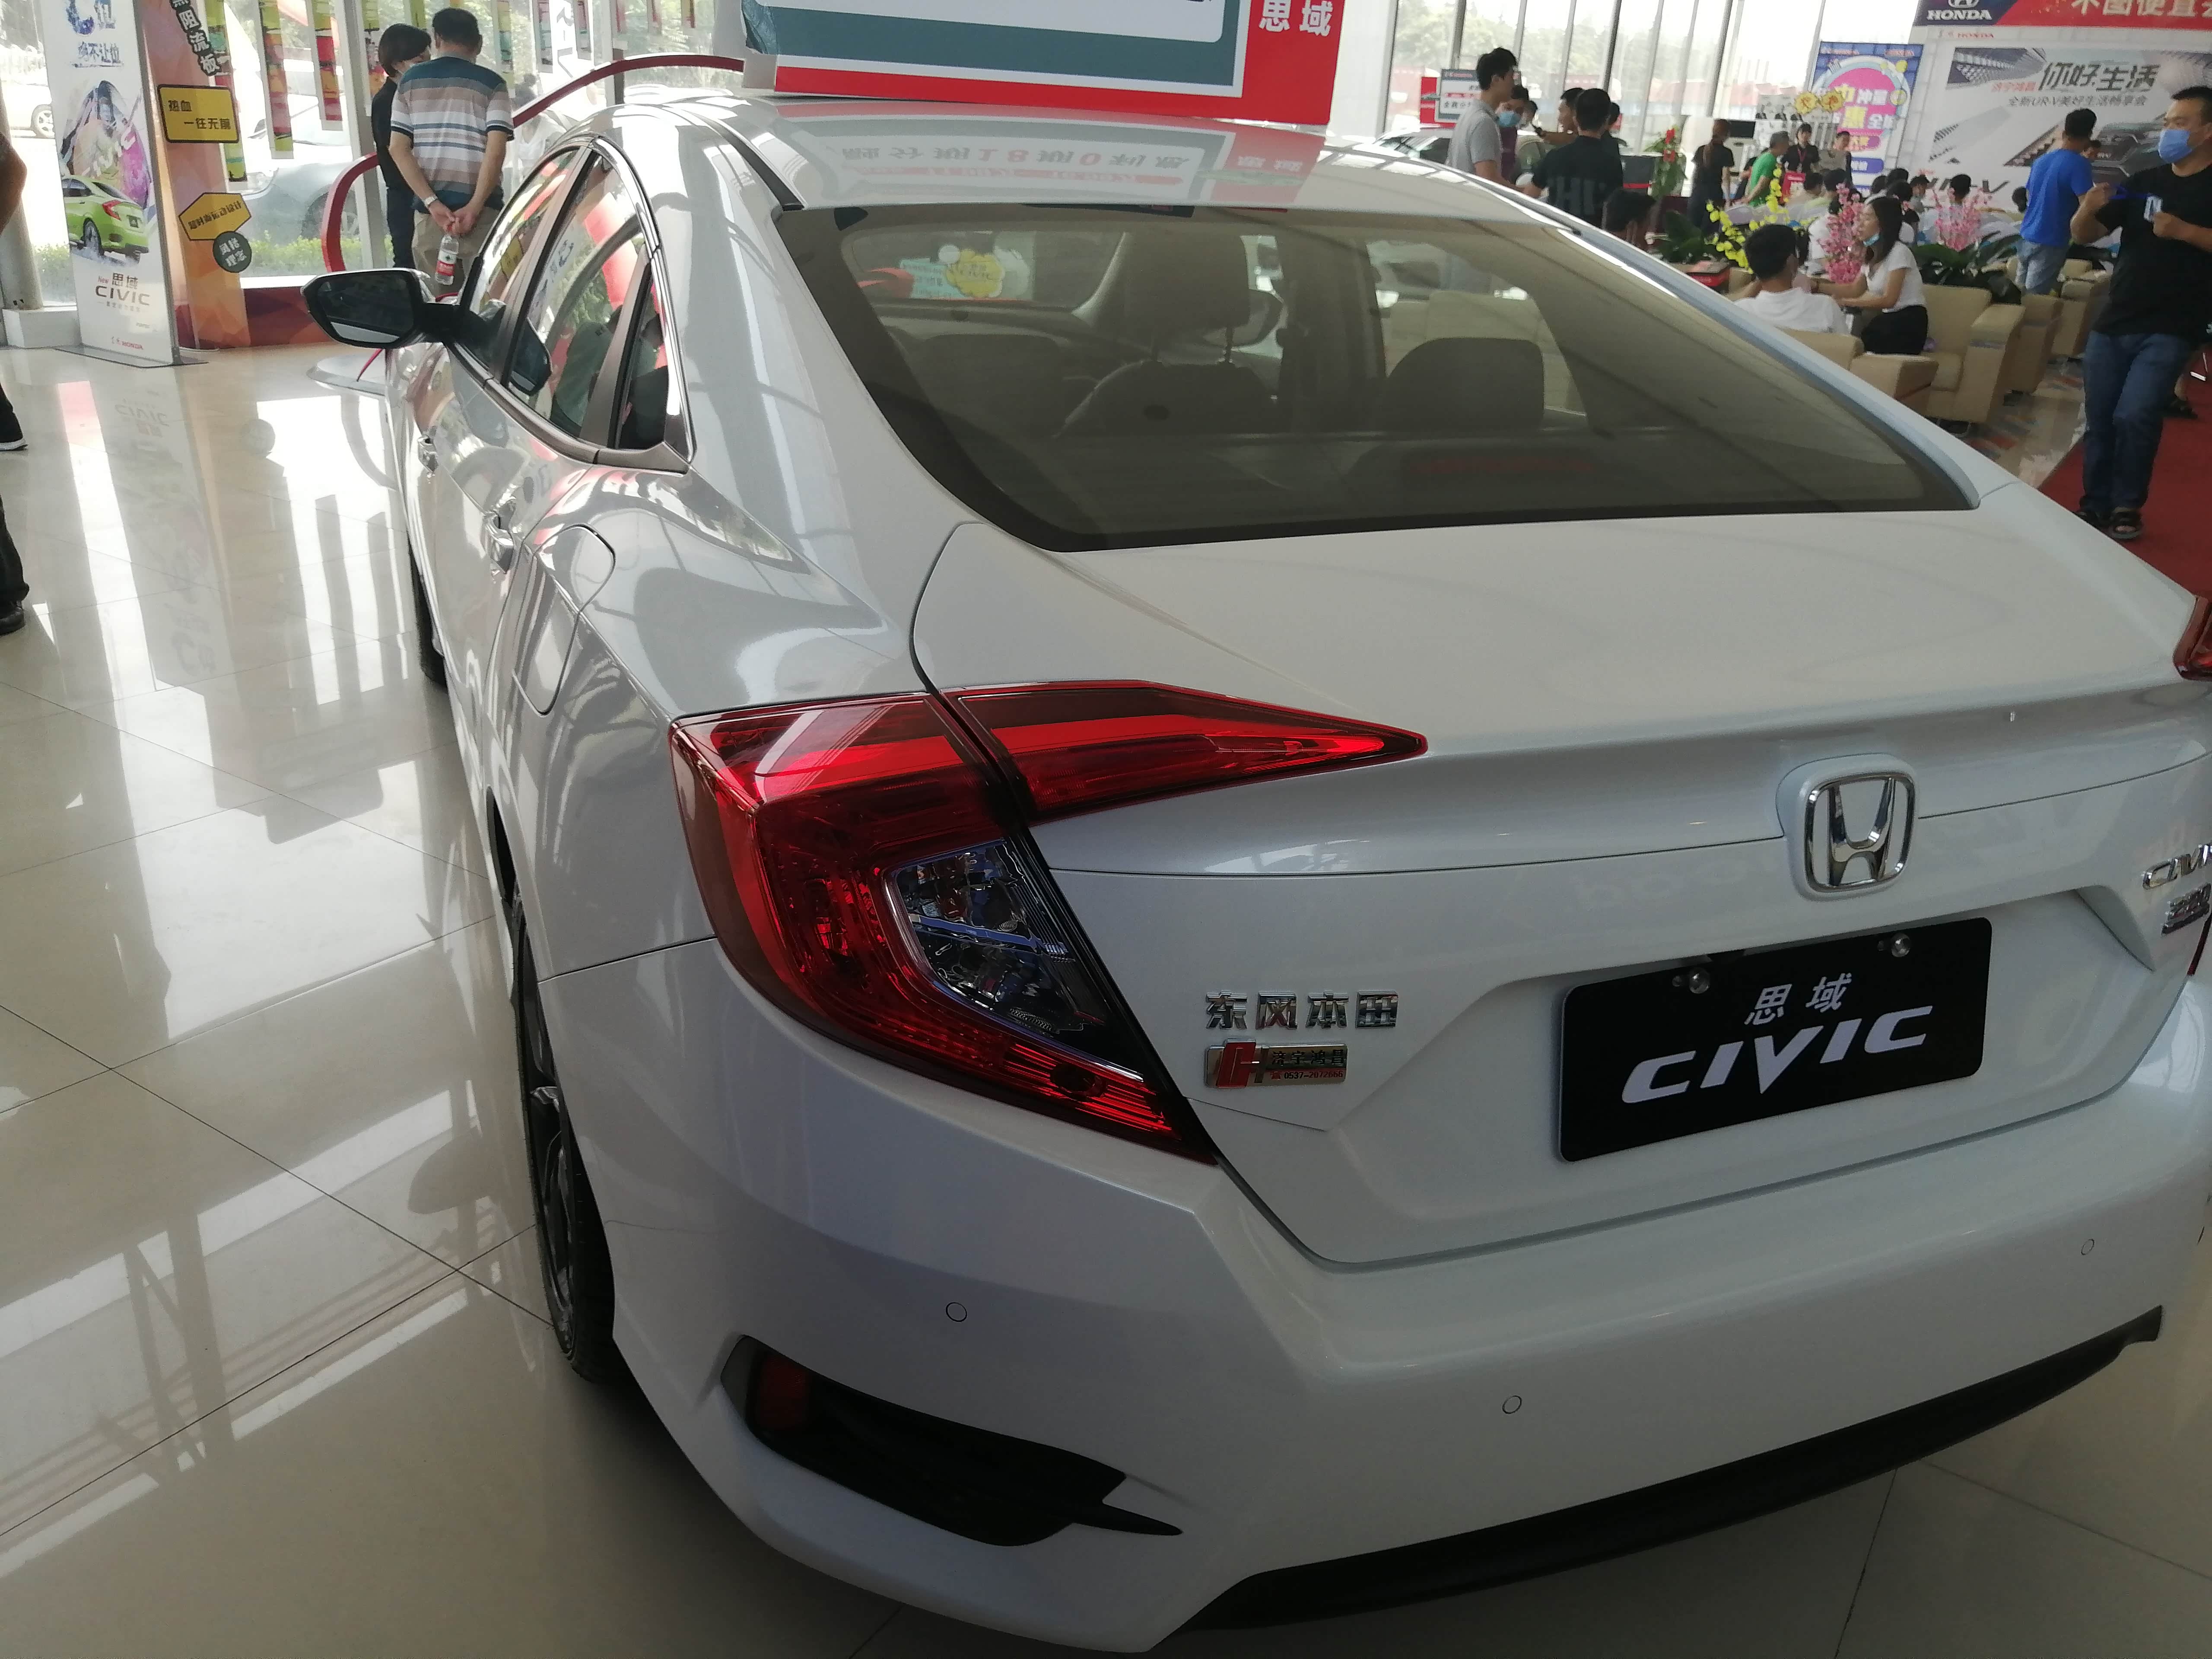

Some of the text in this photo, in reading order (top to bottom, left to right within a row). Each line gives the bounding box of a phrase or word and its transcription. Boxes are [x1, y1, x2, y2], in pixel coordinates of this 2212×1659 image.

[1259, 0, 1333, 36] 思域
[1926, 10, 1992, 20] HONDA
[2038, 62, 2161, 92] 你好生活
[168, 100, 192, 111] 热血
[184, 118, 231, 130] 一往无前
[112, 272, 138, 289] 思域
[95, 285, 150, 305] CIVIC
[2142, 844, 2212, 890] CIVI
[1205, 990, 1398, 1030] 东风本田
[1744, 972, 1852, 1026] 思域
[1271, 1049, 1344, 1066] 济宁鸿昌
[1621, 1005, 1933, 1104] CIVIC
